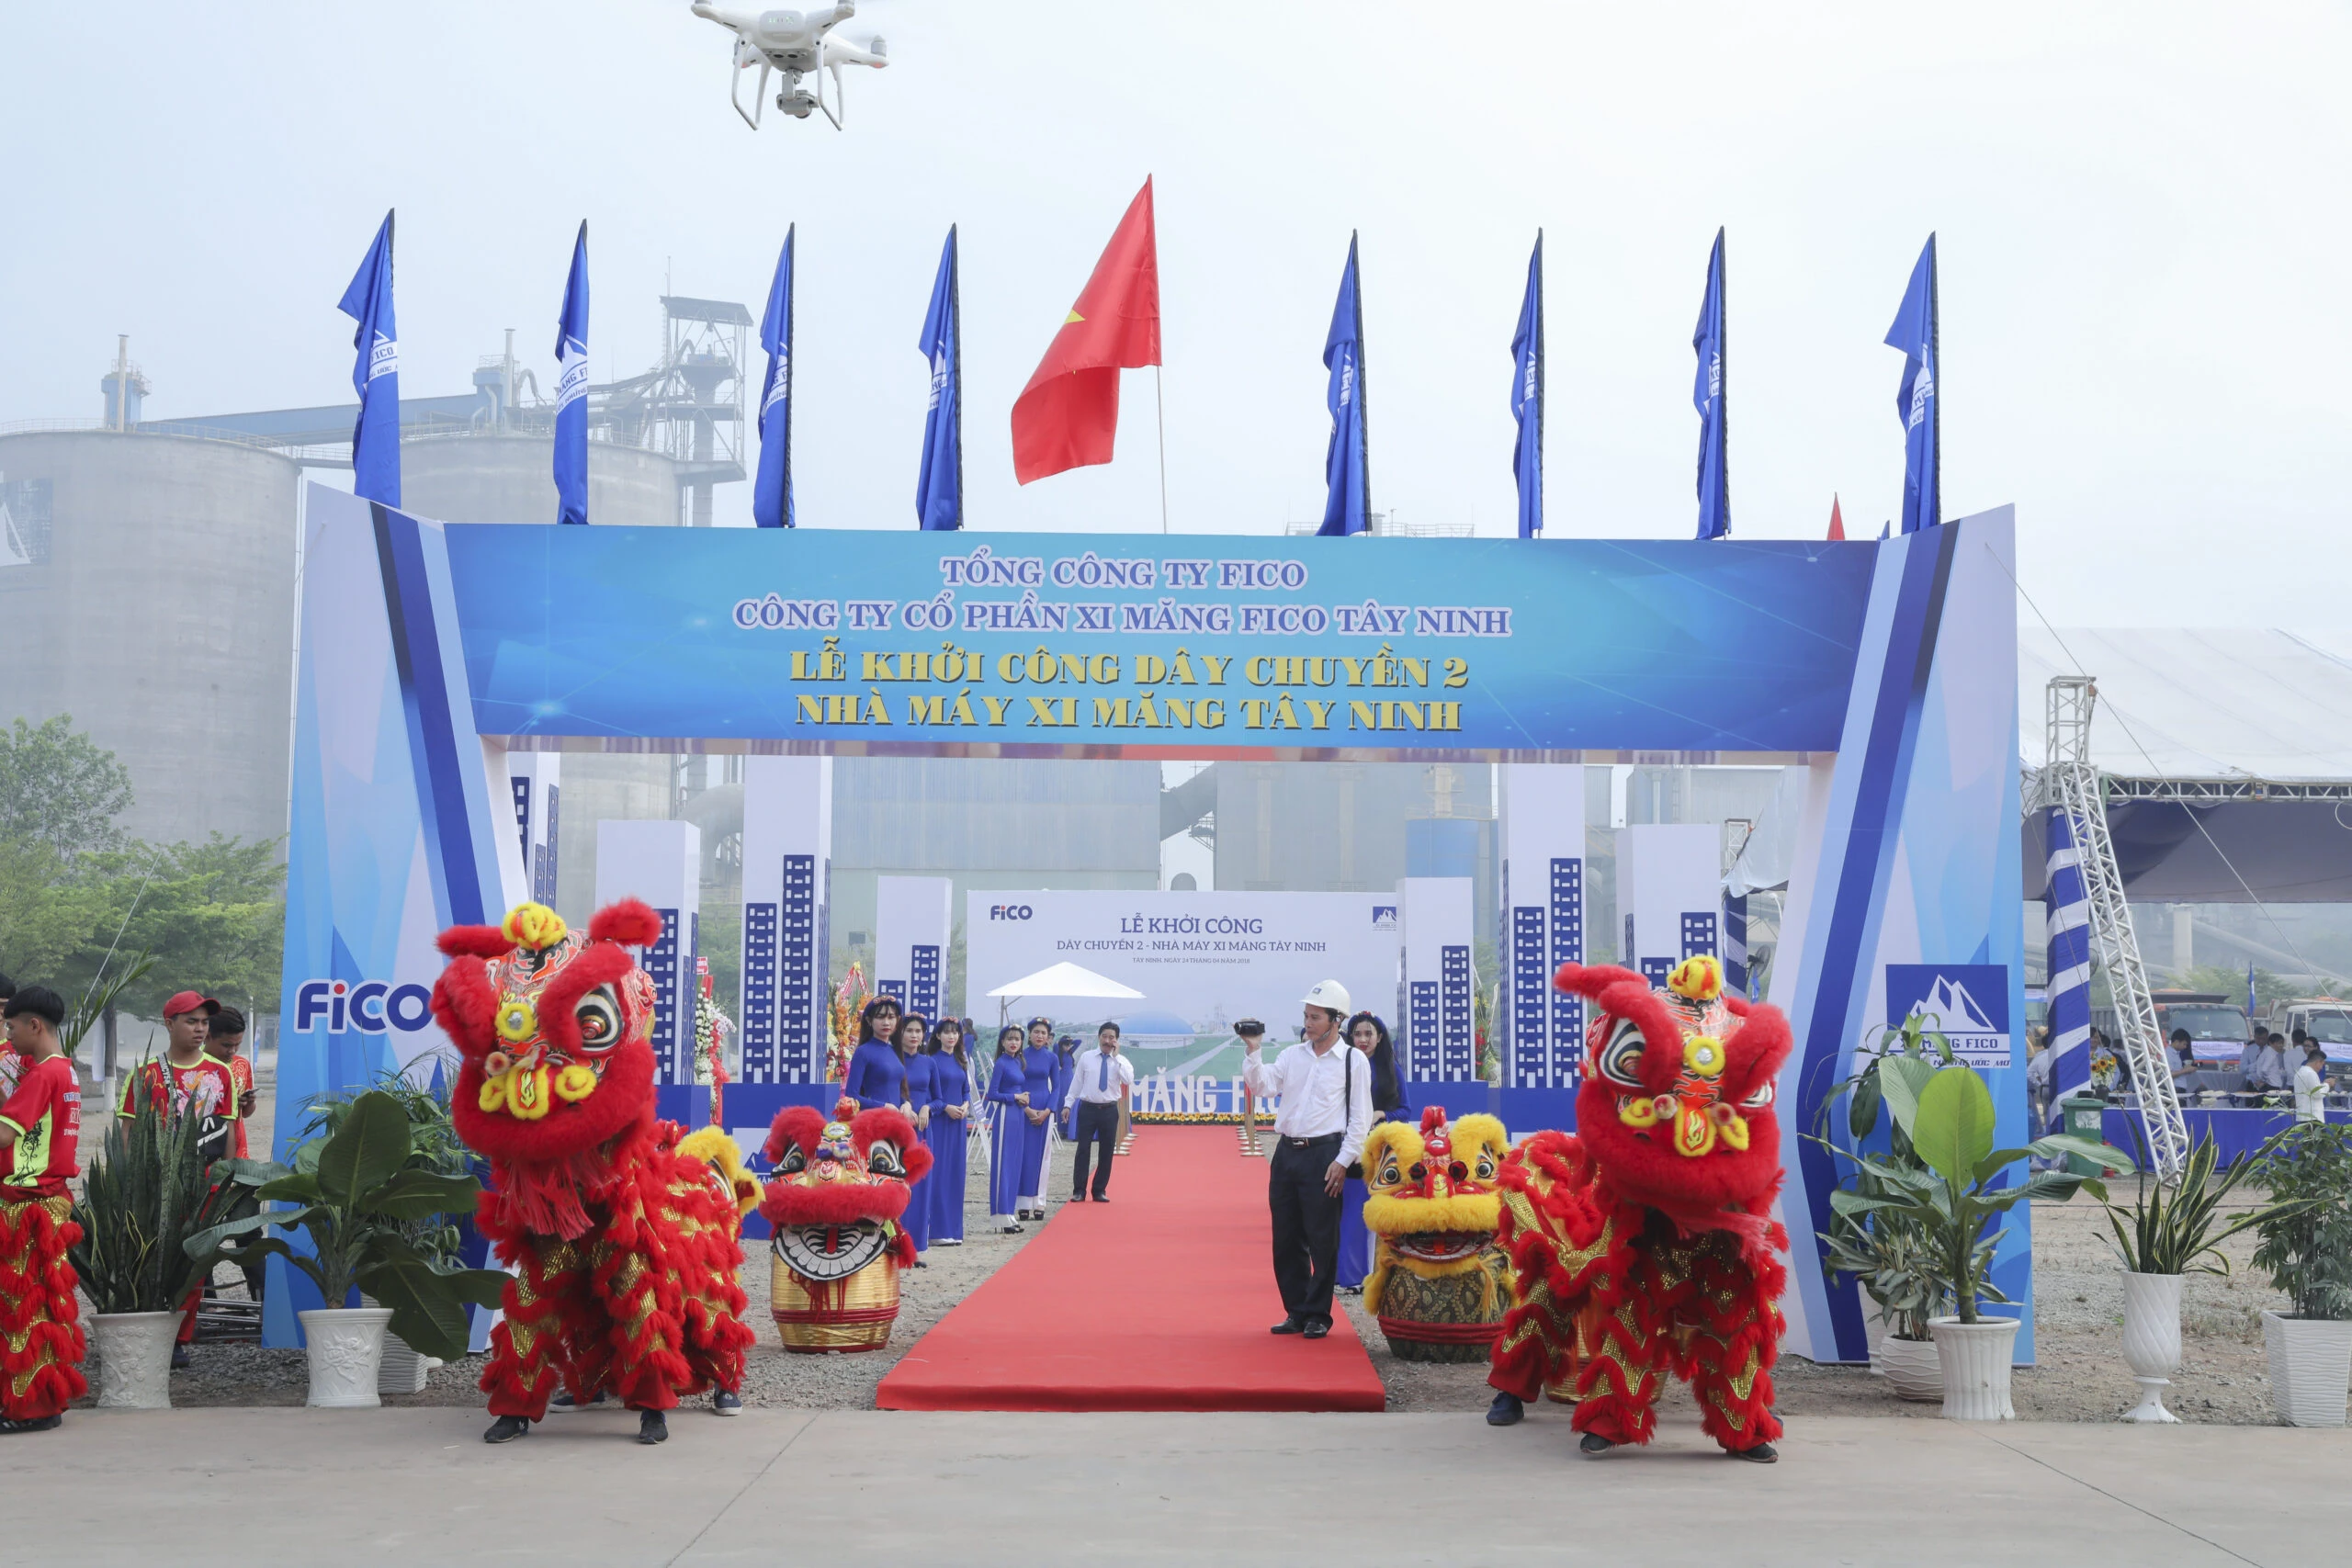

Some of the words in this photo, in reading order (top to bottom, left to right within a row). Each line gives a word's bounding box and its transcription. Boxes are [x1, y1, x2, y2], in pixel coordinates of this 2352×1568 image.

[942, 547, 1042, 584] TỔNG
[1053, 553, 1154, 586] CÔNG
[1164, 562, 1209, 587] TY
[1220, 562, 1306, 587] FICO
[735, 595, 837, 627] CÔNG
[848, 603, 894, 627] TY
[904, 591, 953, 628] CỔ
[964, 592, 1068, 629] PHẦN
[1075, 605, 1114, 629] XI
[1124, 601, 1231, 631] MĂNG
[1242, 607, 1327, 632] FICO
[1337, 603, 1408, 633] TÂY
[1417, 610, 1510, 634] NINH
[789, 636, 847, 682] LỄ
[860, 641, 984, 682] KHỞI
[997, 644, 1121, 683] CÔNG
[1134, 646, 1233, 685] DÂY
[1244, 642, 1430, 687] CHUYỀN
[1442, 658, 1469, 689] 2
[795, 686, 892, 726] NHÀ
[906, 687, 1012, 727] MÁY
[1025, 696, 1080, 727] XI
[1092, 690, 1227, 728] MĂNG
[1238, 691, 1336, 730] TÂY
[1347, 701, 1462, 731] NINH
[1120, 912, 1144, 933] LỄ
[1148, 913, 1201, 933] KHỞI
[1204, 915, 1262, 934] CÔNG
[1136, 941, 1143, 951] 2
[1152, 939, 1180, 951] NHÀ
[1182, 939, 1211, 951] MÁY
[1213, 941, 1227, 951] XI
[1295, 942, 1327, 952] NINH
[1965, 1038, 1998, 1049] FICO
